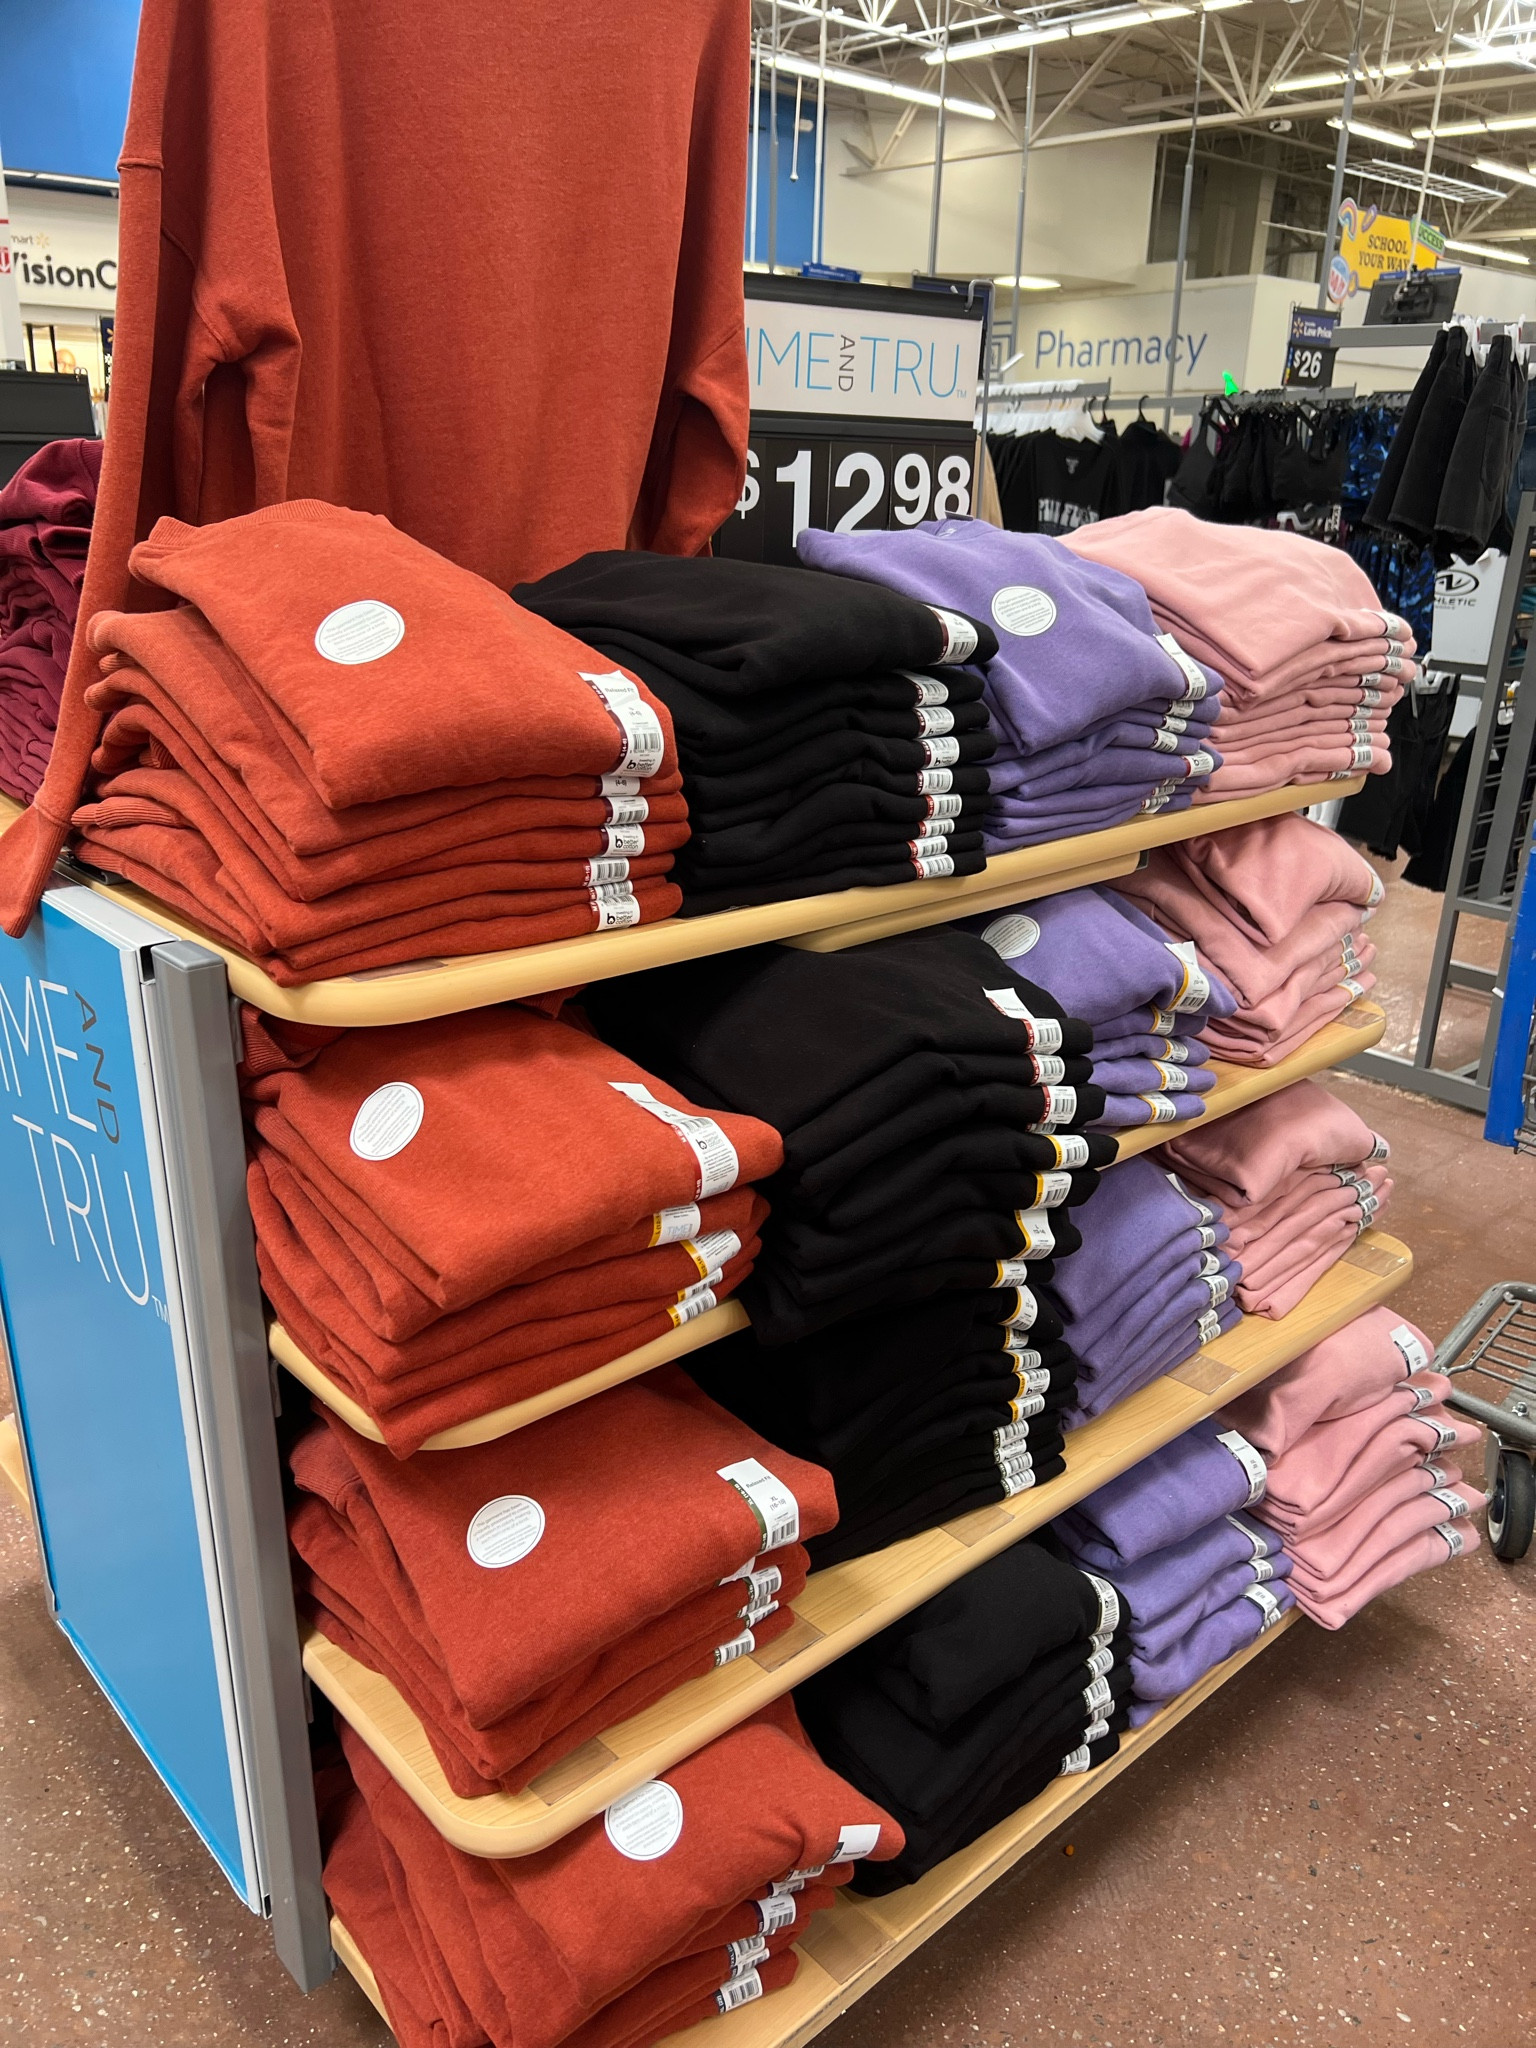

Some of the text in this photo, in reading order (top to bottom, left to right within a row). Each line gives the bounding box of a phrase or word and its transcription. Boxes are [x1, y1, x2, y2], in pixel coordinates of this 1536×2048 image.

[1368, 234, 1408, 255] SCHOOL
[1418, 223, 1444, 251] UCCESS
[13, 252, 117, 290] isionC
[1359, 251, 1384, 270] YOUR
[745, 326, 834, 391] IME
[838, 334, 856, 393] AND
[860, 335, 960, 399] TRU
[1035, 329, 1208, 376] Pharmacy
[1293, 350, 1323, 379] $26
[74, 989, 121, 1145] AND
[12, 1114, 150, 1306] TRU
